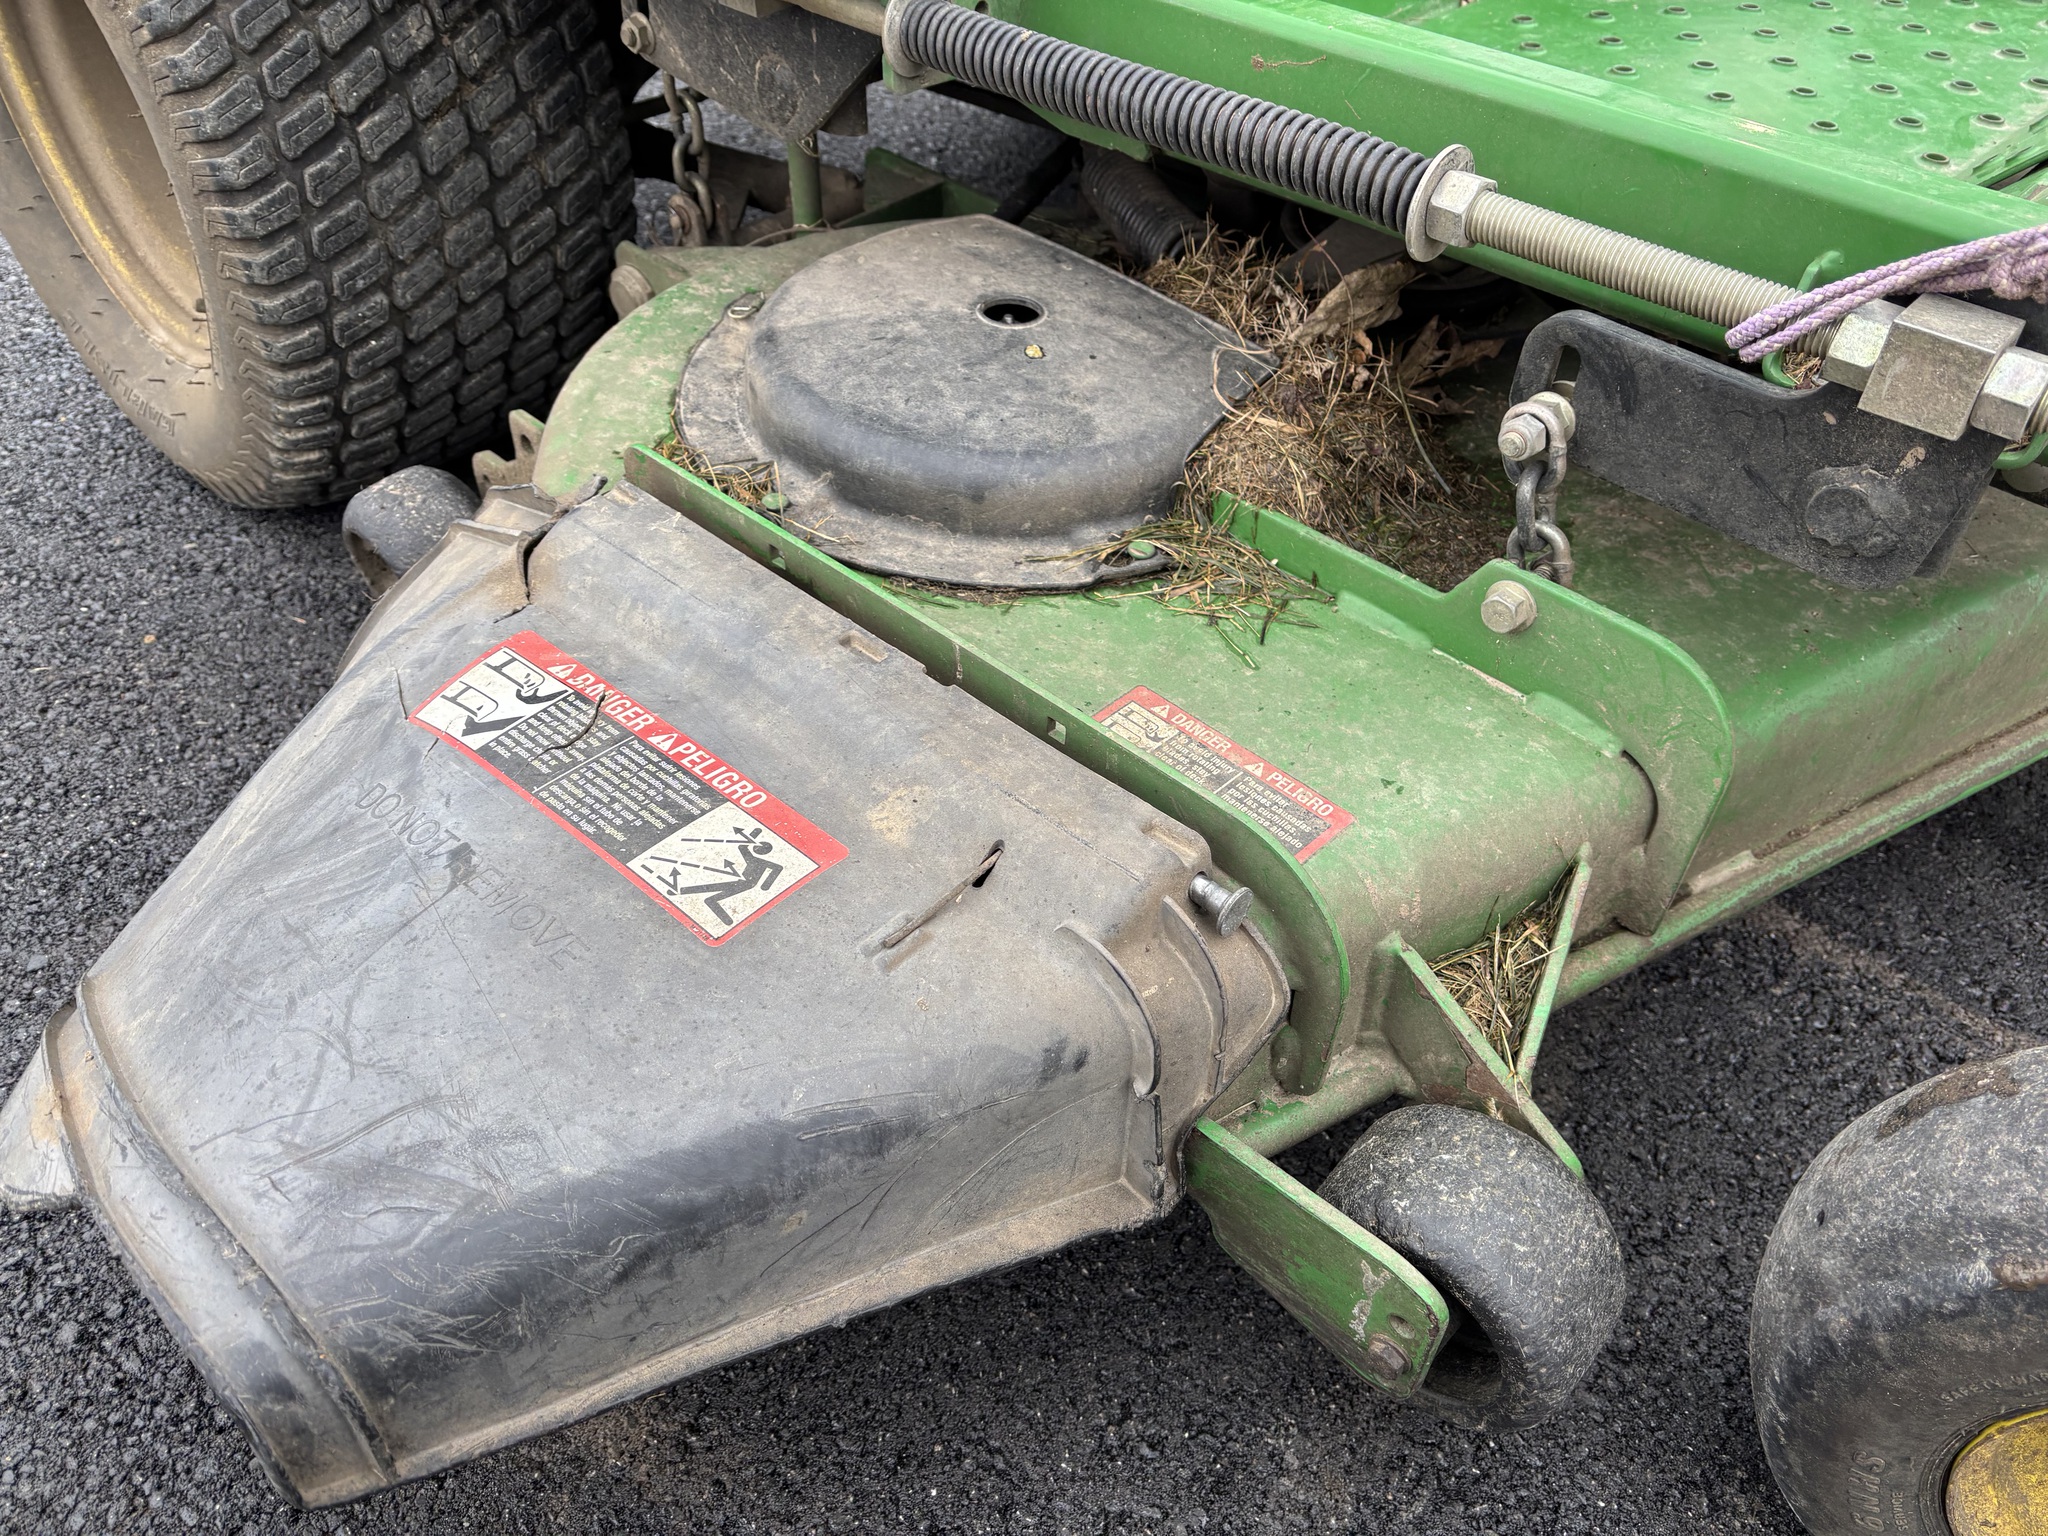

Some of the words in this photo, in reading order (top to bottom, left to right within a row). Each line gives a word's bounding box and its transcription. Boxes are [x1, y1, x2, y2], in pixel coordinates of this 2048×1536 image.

[556, 700, 579, 717] rotating
[595, 731, 611, 740] and
[566, 672, 656, 732] DANGER
[572, 699, 591, 711] avoid
[604, 724, 620, 736] from
[508, 729, 535, 748] discharge
[517, 722, 528, 730] Do
[525, 728, 538, 737] not
[534, 735, 551, 746] mow
[527, 717, 542, 726] and
[537, 723, 553, 735] keep
[550, 733, 574, 750] others
[568, 748, 586, 762] away.
[537, 712, 554, 722] clear
[556, 724, 572, 736] deck
[547, 705, 568, 720] thrown
[586, 736, 602, 747] stay
[1171, 713, 1231, 753] DANGER
[492, 745, 511, 758] place.
[498, 735, 516, 748] entire
[511, 746, 530, 758] grass
[527, 756, 552, 774] catcher
[628, 739, 645, 751] Para
[642, 750, 661, 762] evitar
[658, 760, 677, 773] sufrir
[674, 771, 700, 790] lesiones
[1154, 751, 1177, 765] clear
[1184, 770, 1205, 785] deck
[1169, 740, 1191, 754] from
[1188, 751, 1221, 775] rotating
[1191, 764, 1211, 779] stay
[588, 762, 621, 784] plataforma
[627, 788, 645, 801] corte
[647, 802, 678, 824] mantener
[599, 756, 622, 772] alejado
[619, 770, 633, 779] del
[629, 776, 648, 790] borde
[619, 746, 648, 765] causadas
[643, 763, 659, 772] por
[656, 771, 683, 790] cuchillas
[680, 789, 711, 810] giratorias
[637, 769, 665, 791] lanzados,
[664, 789, 700, 815] mantenerse
[668, 740, 769, 810] PELIGRO
[1243, 776, 1264, 792] Para
[1263, 790, 1291, 807] evitar
[538, 790, 549, 798] de
[544, 796, 565, 810] pasto
[570, 814, 581, 822] su
[559, 778, 585, 798] máquina
[582, 796, 595, 805] sin
[598, 806, 615, 819] tubo
[612, 817, 623, 825] de
[584, 770, 596, 779] las
[593, 777, 615, 792] demás
[610, 790, 641, 811] personas
[638, 809, 665, 829] alejadas
[610, 802, 622, 811] No
[620, 809, 636, 821] usar
[1226, 788, 1244, 799] por
[1243, 796, 1258, 808] las
[1258, 807, 1299, 835] cuchillas,
[1236, 781, 1271, 806] lesiones
[1271, 805, 1314, 832] causadas
[1266, 772, 1333, 817] PELIGRO
[355, 782, 402, 819] DO
[389, 806, 461, 860] NOT
[578, 806, 591, 815] sin
[594, 818, 627, 841] recogedor
[1221, 792, 1270, 826] mantenerse
[1269, 825, 1302, 848] alejado
[1940, 1379, 2002, 1402] SAFETY
[1892, 1492, 1909, 1532] SERVICE
